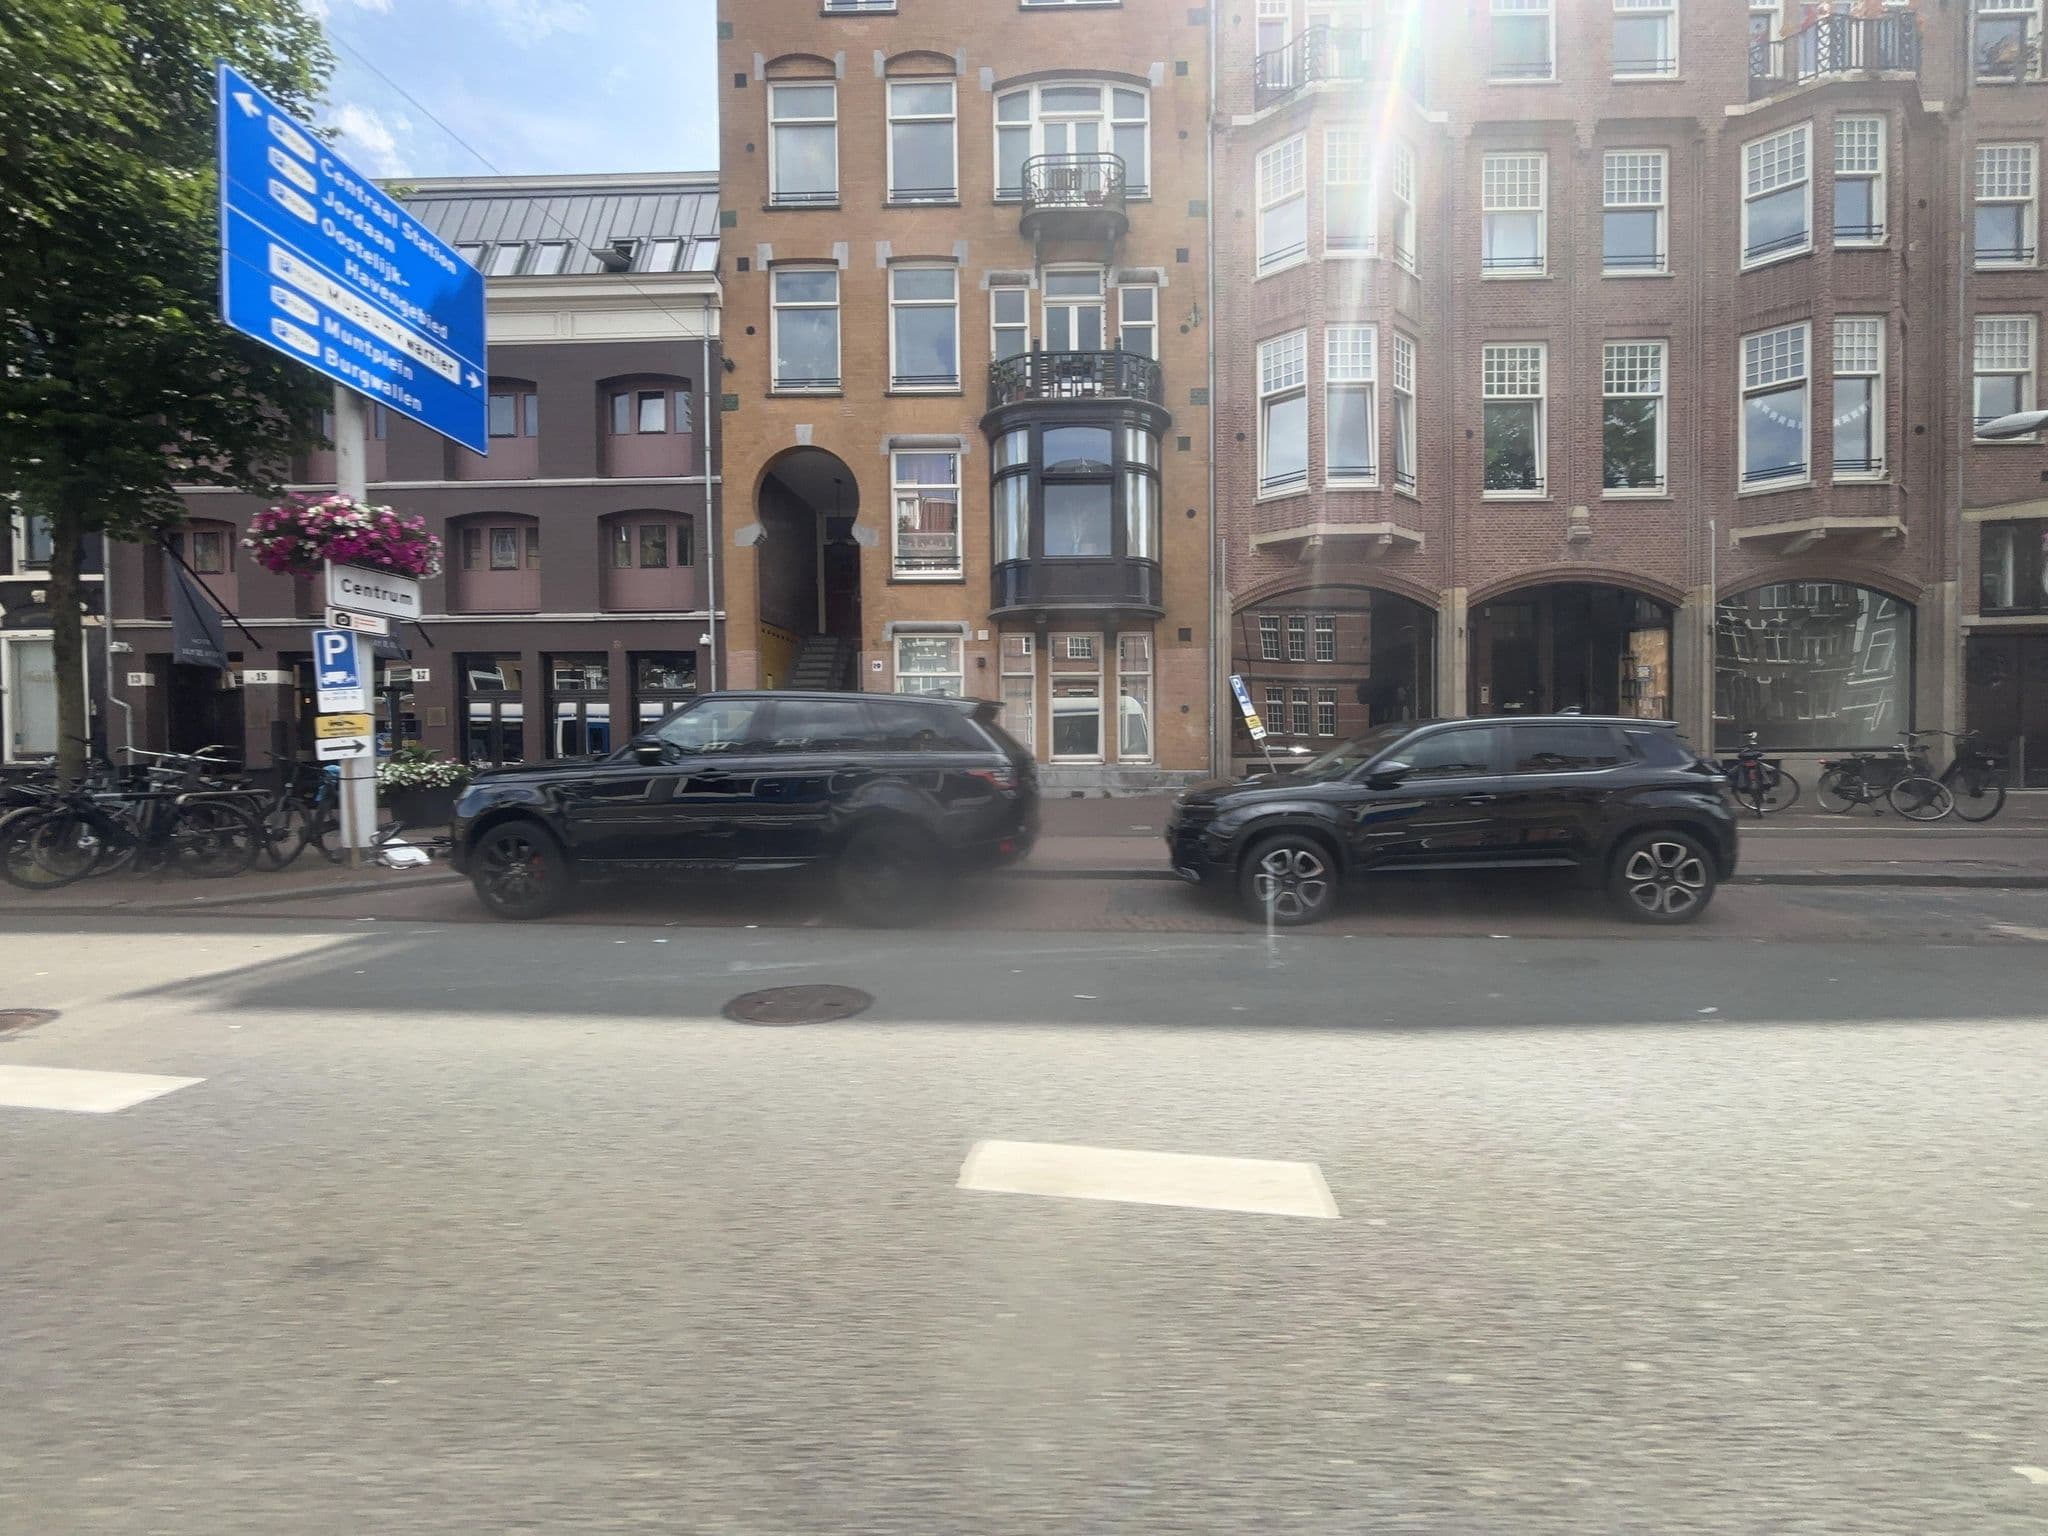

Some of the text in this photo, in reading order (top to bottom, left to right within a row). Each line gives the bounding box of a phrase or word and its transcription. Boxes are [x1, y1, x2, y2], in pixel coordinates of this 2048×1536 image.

[321, 158, 457, 275] Centraal Station
[321, 191, 396, 254] Jordaan
[321, 217, 411, 288] Oostelijk-
[344, 258, 448, 340] Havengebied
[324, 316, 414, 381] Muntplein
[324, 346, 423, 412] Burgwallen
[340, 578, 413, 606] Centrum
[255, 672, 268, 682] 15
[323, 634, 348, 666] P
